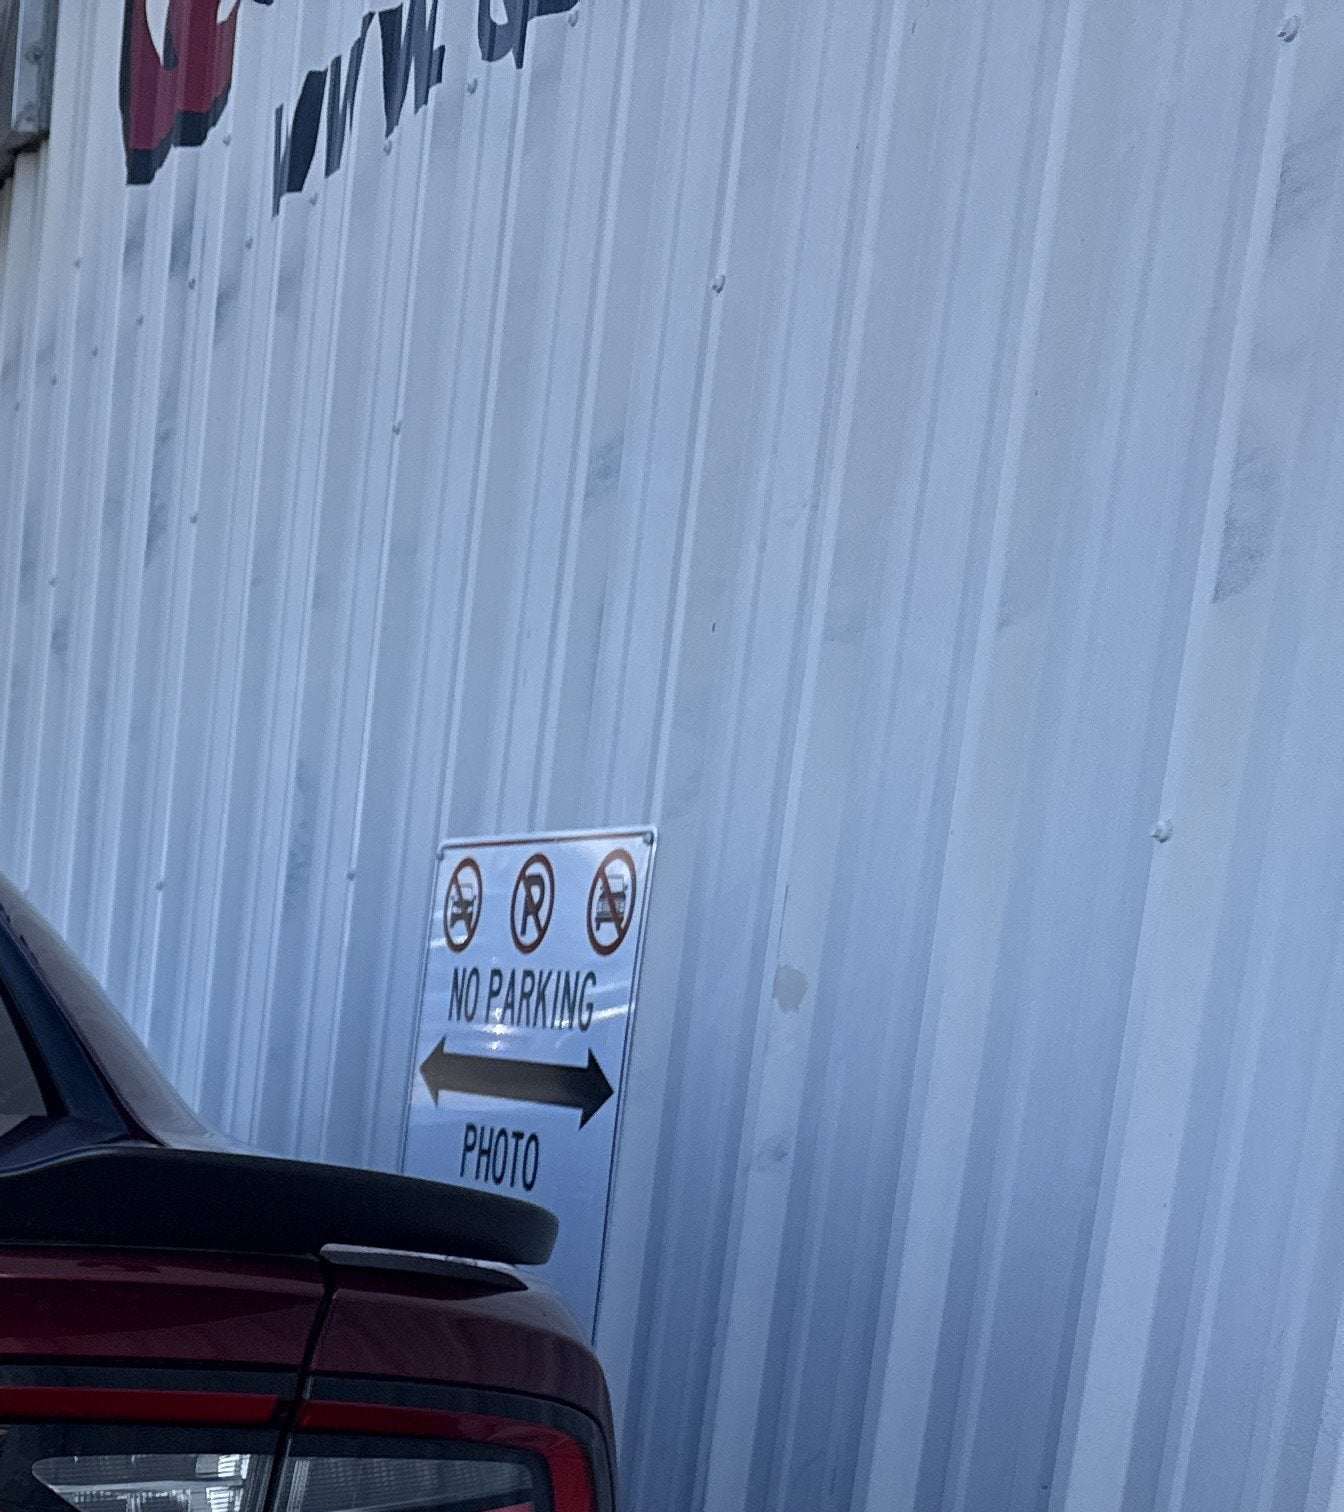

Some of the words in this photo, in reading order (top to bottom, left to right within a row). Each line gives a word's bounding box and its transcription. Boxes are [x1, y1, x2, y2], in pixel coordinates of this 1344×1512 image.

[448, 966, 480, 1024] NO
[485, 968, 596, 1032] PARKING
[459, 1122, 540, 1191] PHOTO
